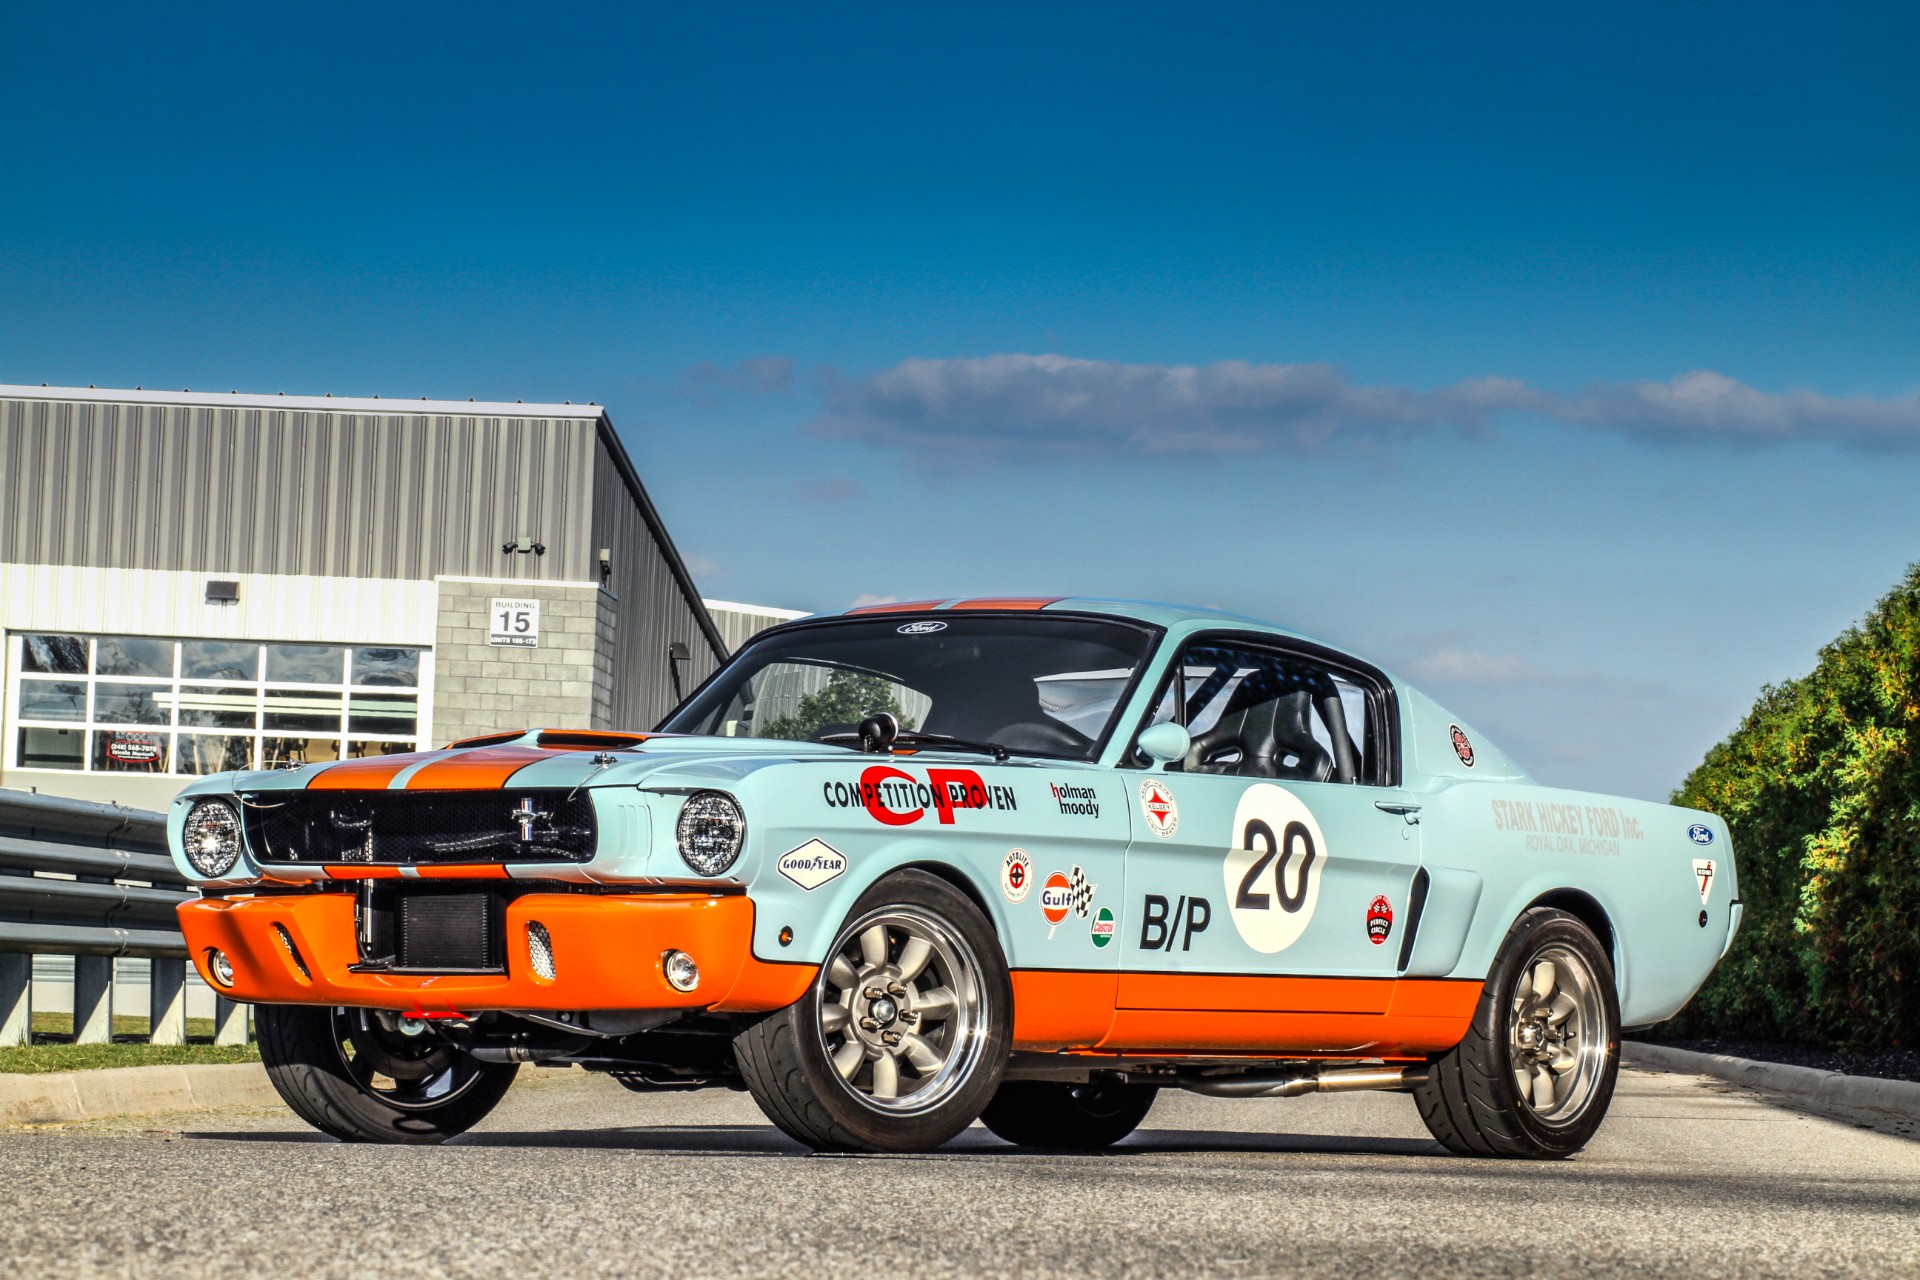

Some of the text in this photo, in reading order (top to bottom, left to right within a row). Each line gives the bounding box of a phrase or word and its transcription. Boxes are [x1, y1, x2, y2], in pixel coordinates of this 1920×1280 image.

[495, 601, 536, 609] BUILDING
[499, 610, 530, 633] 15
[905, 622, 939, 632] Ford
[491, 636, 511, 644] UNITS
[823, 781, 1018, 811] COMPETITION PROVEN
[859, 765, 988, 826] CP
[1050, 781, 1097, 800] holman
[1059, 799, 1099, 819] moody
[1147, 803, 1171, 811] KELSEY
[1491, 799, 1645, 841] STARK HICKEY FORD Inc.
[1692, 826, 1710, 842] Ford
[1526, 834, 1620, 857] ROYAL OAK, MICHIGAN
[1006, 851, 1030, 868] AUTOLITE
[1235, 817, 1316, 914] 20
[1698, 868, 1712, 876] KONI
[1042, 890, 1072, 906] Gulf
[1093, 921, 1115, 933] Castrol
[1139, 893, 1212, 953] B/P
[1370, 918, 1389, 928] PERFECT
[1371, 926, 1386, 935] CIRCLE
